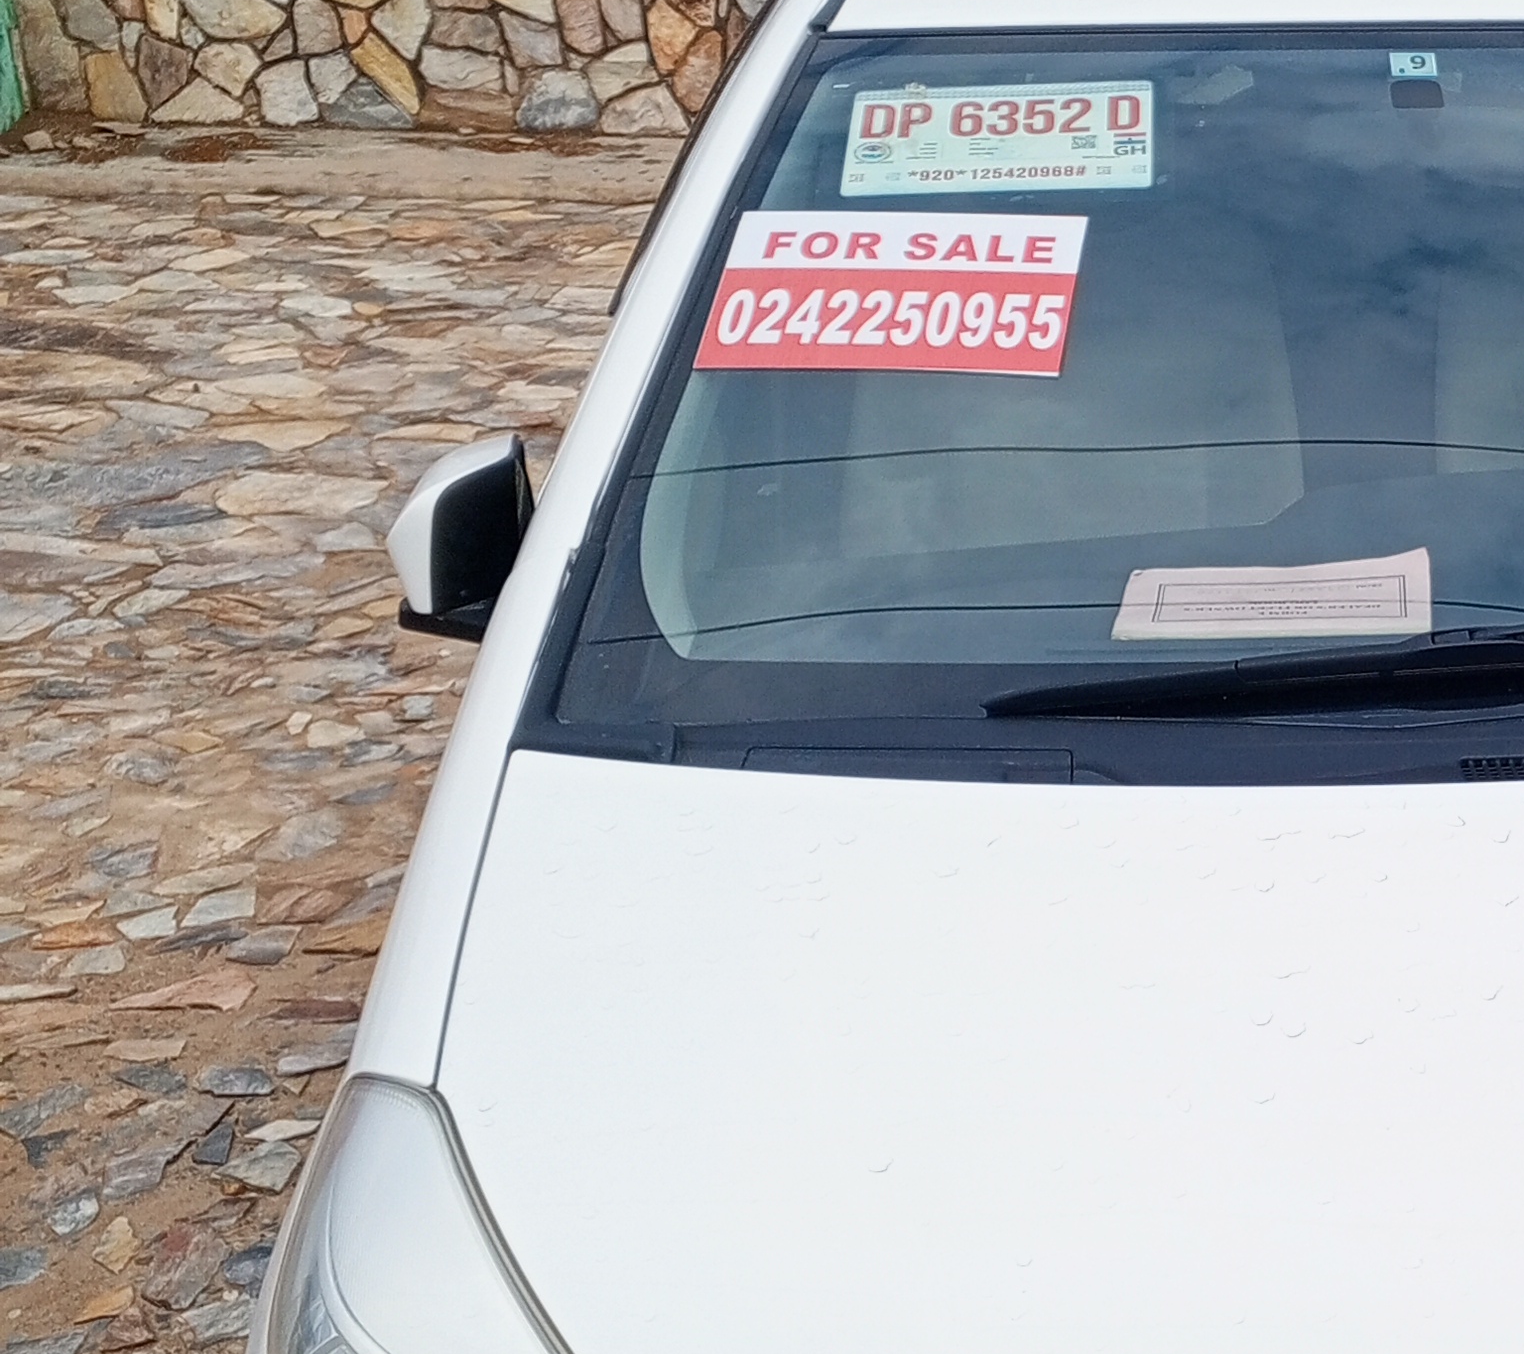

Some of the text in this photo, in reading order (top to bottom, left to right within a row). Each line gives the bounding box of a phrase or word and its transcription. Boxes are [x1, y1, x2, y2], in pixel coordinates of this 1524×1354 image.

[859, 94, 1141, 139] DP 6352 D
[1113, 145, 1146, 156] GH
[761, 231, 1057, 263] FOR SALE
[717, 288, 1066, 349] 0242250955
